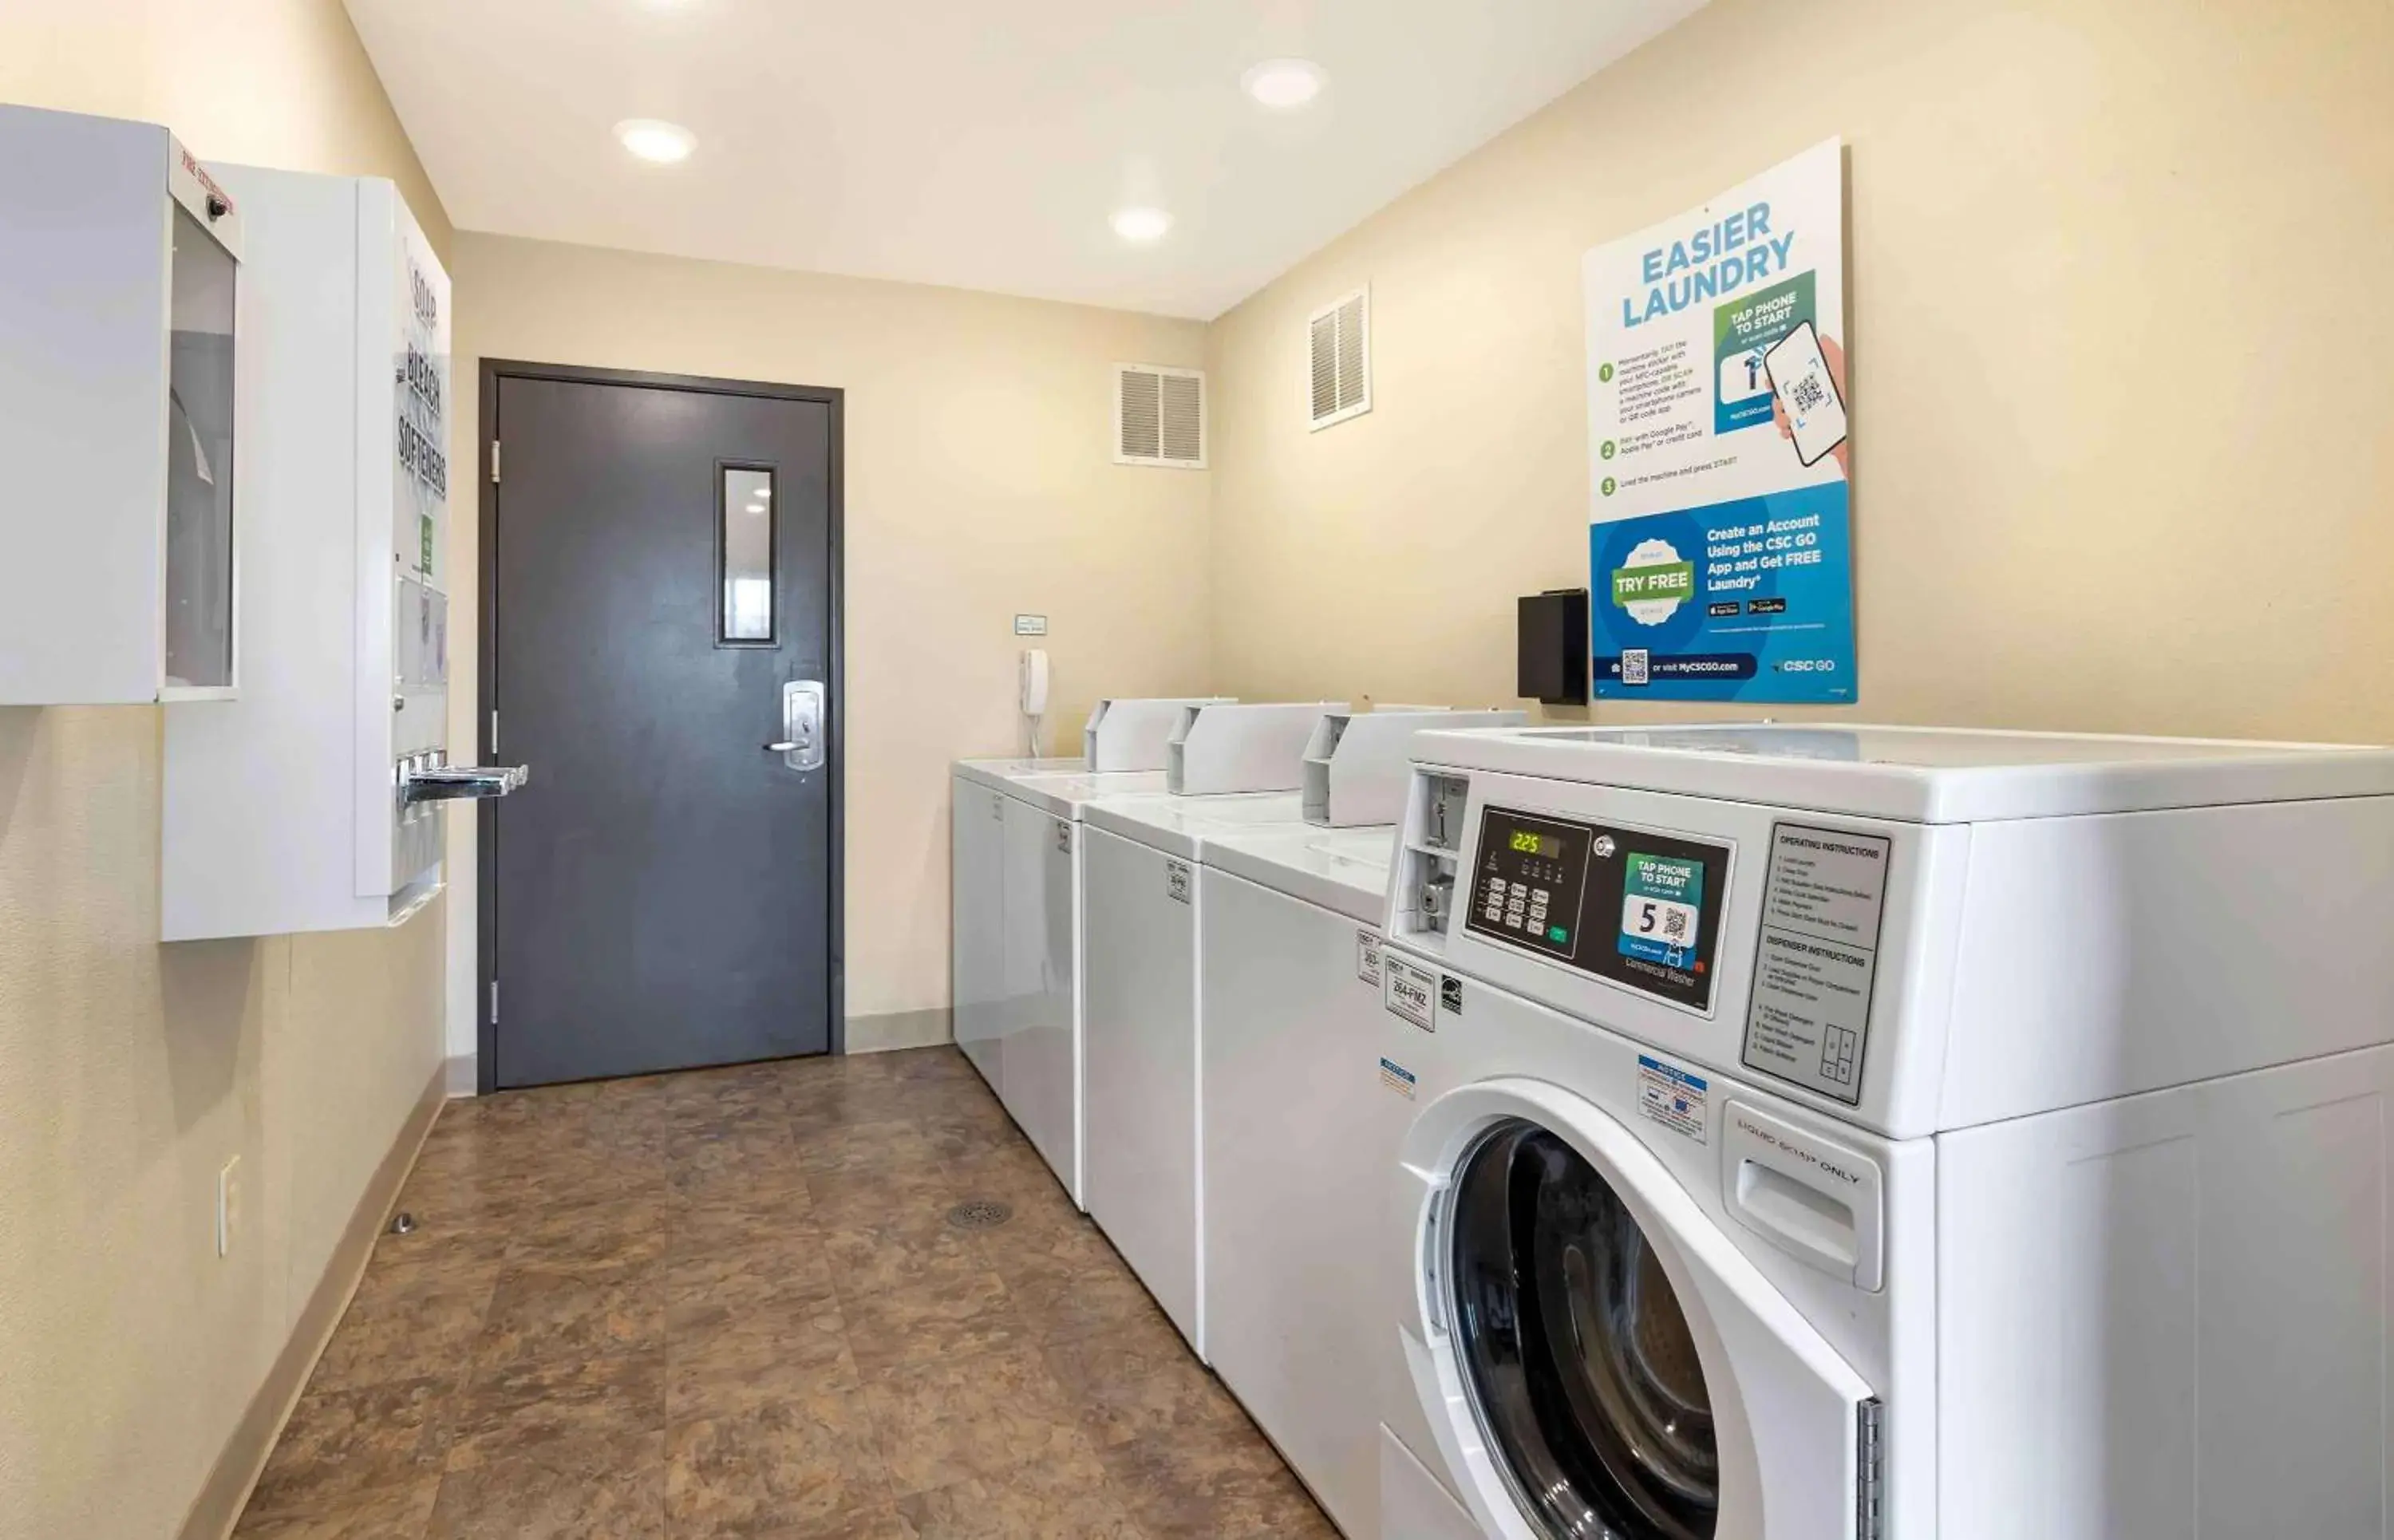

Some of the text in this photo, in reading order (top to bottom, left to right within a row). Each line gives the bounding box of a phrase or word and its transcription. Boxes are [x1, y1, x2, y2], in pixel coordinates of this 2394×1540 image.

[1643, 202, 1771, 283] EASIER
[1623, 230, 1794, 328] LAUNDRY
[1732, 292, 1797, 325] TAP PHONE
[1736, 306, 1792, 334] TO START
[408, 342, 440, 412] BLEACH
[1649, 426, 1674, 438] Google
[399, 415, 446, 492] SOFTENERS
[1679, 465, 1692, 475] and
[1707, 513, 1820, 541] Create an Account
[1707, 532, 1816, 558] Using the CSC GO
[1708, 550, 1822, 576] App and Get FREE
[1617, 571, 1688, 593] TRY FREE
[1679, 661, 1738, 673] MyCSCGO.com
[1784, 660, 1835, 672] CSC GO
[1780, 835, 1879, 859] OPERATING INSTRUCTIONS
[1638, 861, 1692, 877] TAP PHONE
[1641, 871, 1685, 887] TO START
[1639, 902, 1657, 933] 5
[1766, 934, 1807, 953] DISPENSER
[1807, 945, 1865, 967] INSTRUCTIONS
[1736, 1118, 1861, 1184] LIQUID SOAP ONLY
